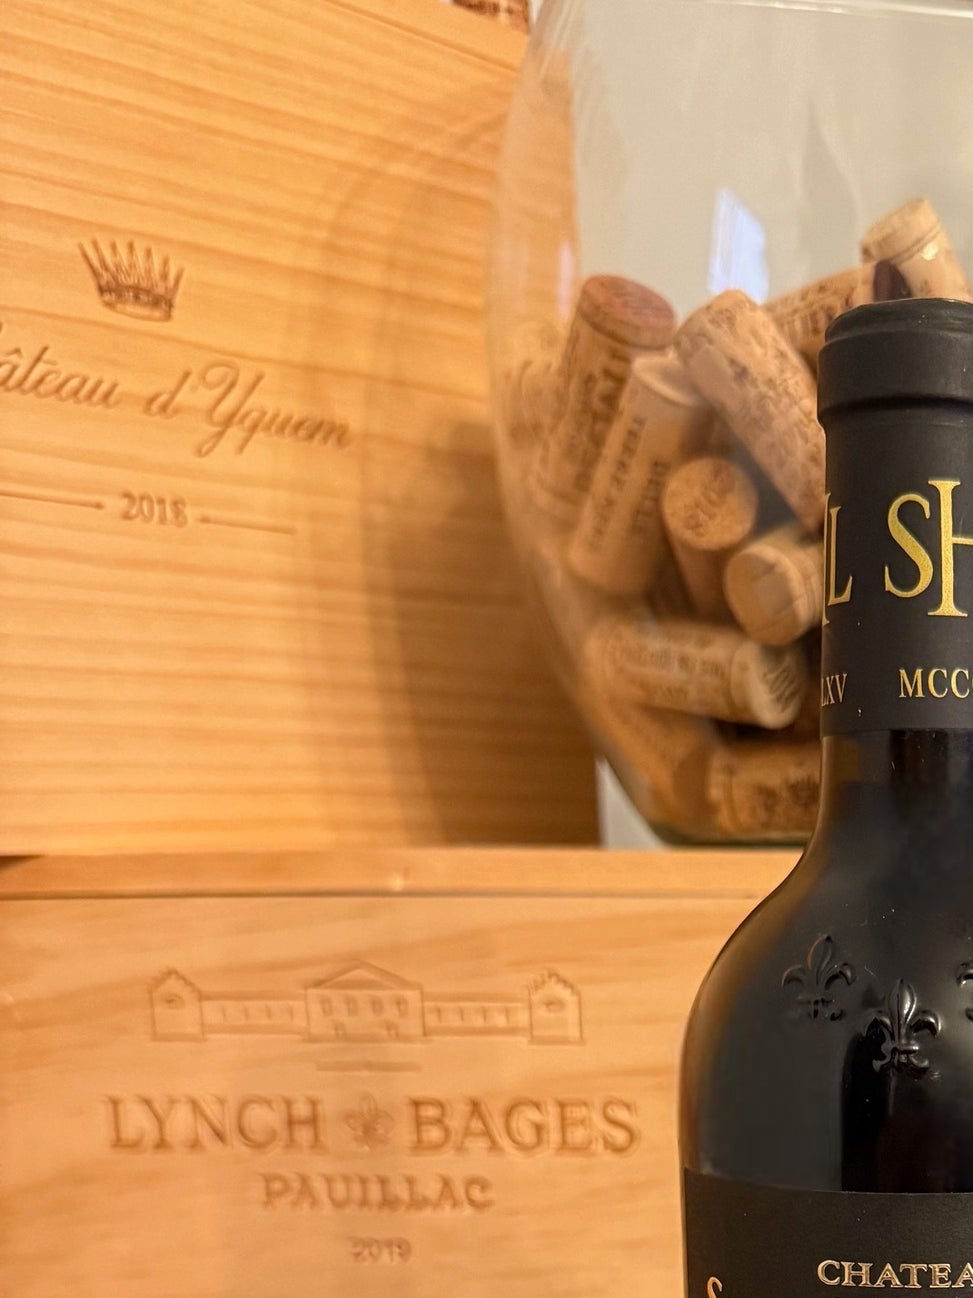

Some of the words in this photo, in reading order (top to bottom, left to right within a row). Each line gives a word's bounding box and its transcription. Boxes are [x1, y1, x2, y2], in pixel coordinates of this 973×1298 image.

[119, 490, 189, 529] 2018
[103, 1095, 323, 1153] LYNCH
[406, 1095, 640, 1156] BAGES
[258, 1171, 496, 1214] PAUILLAC
